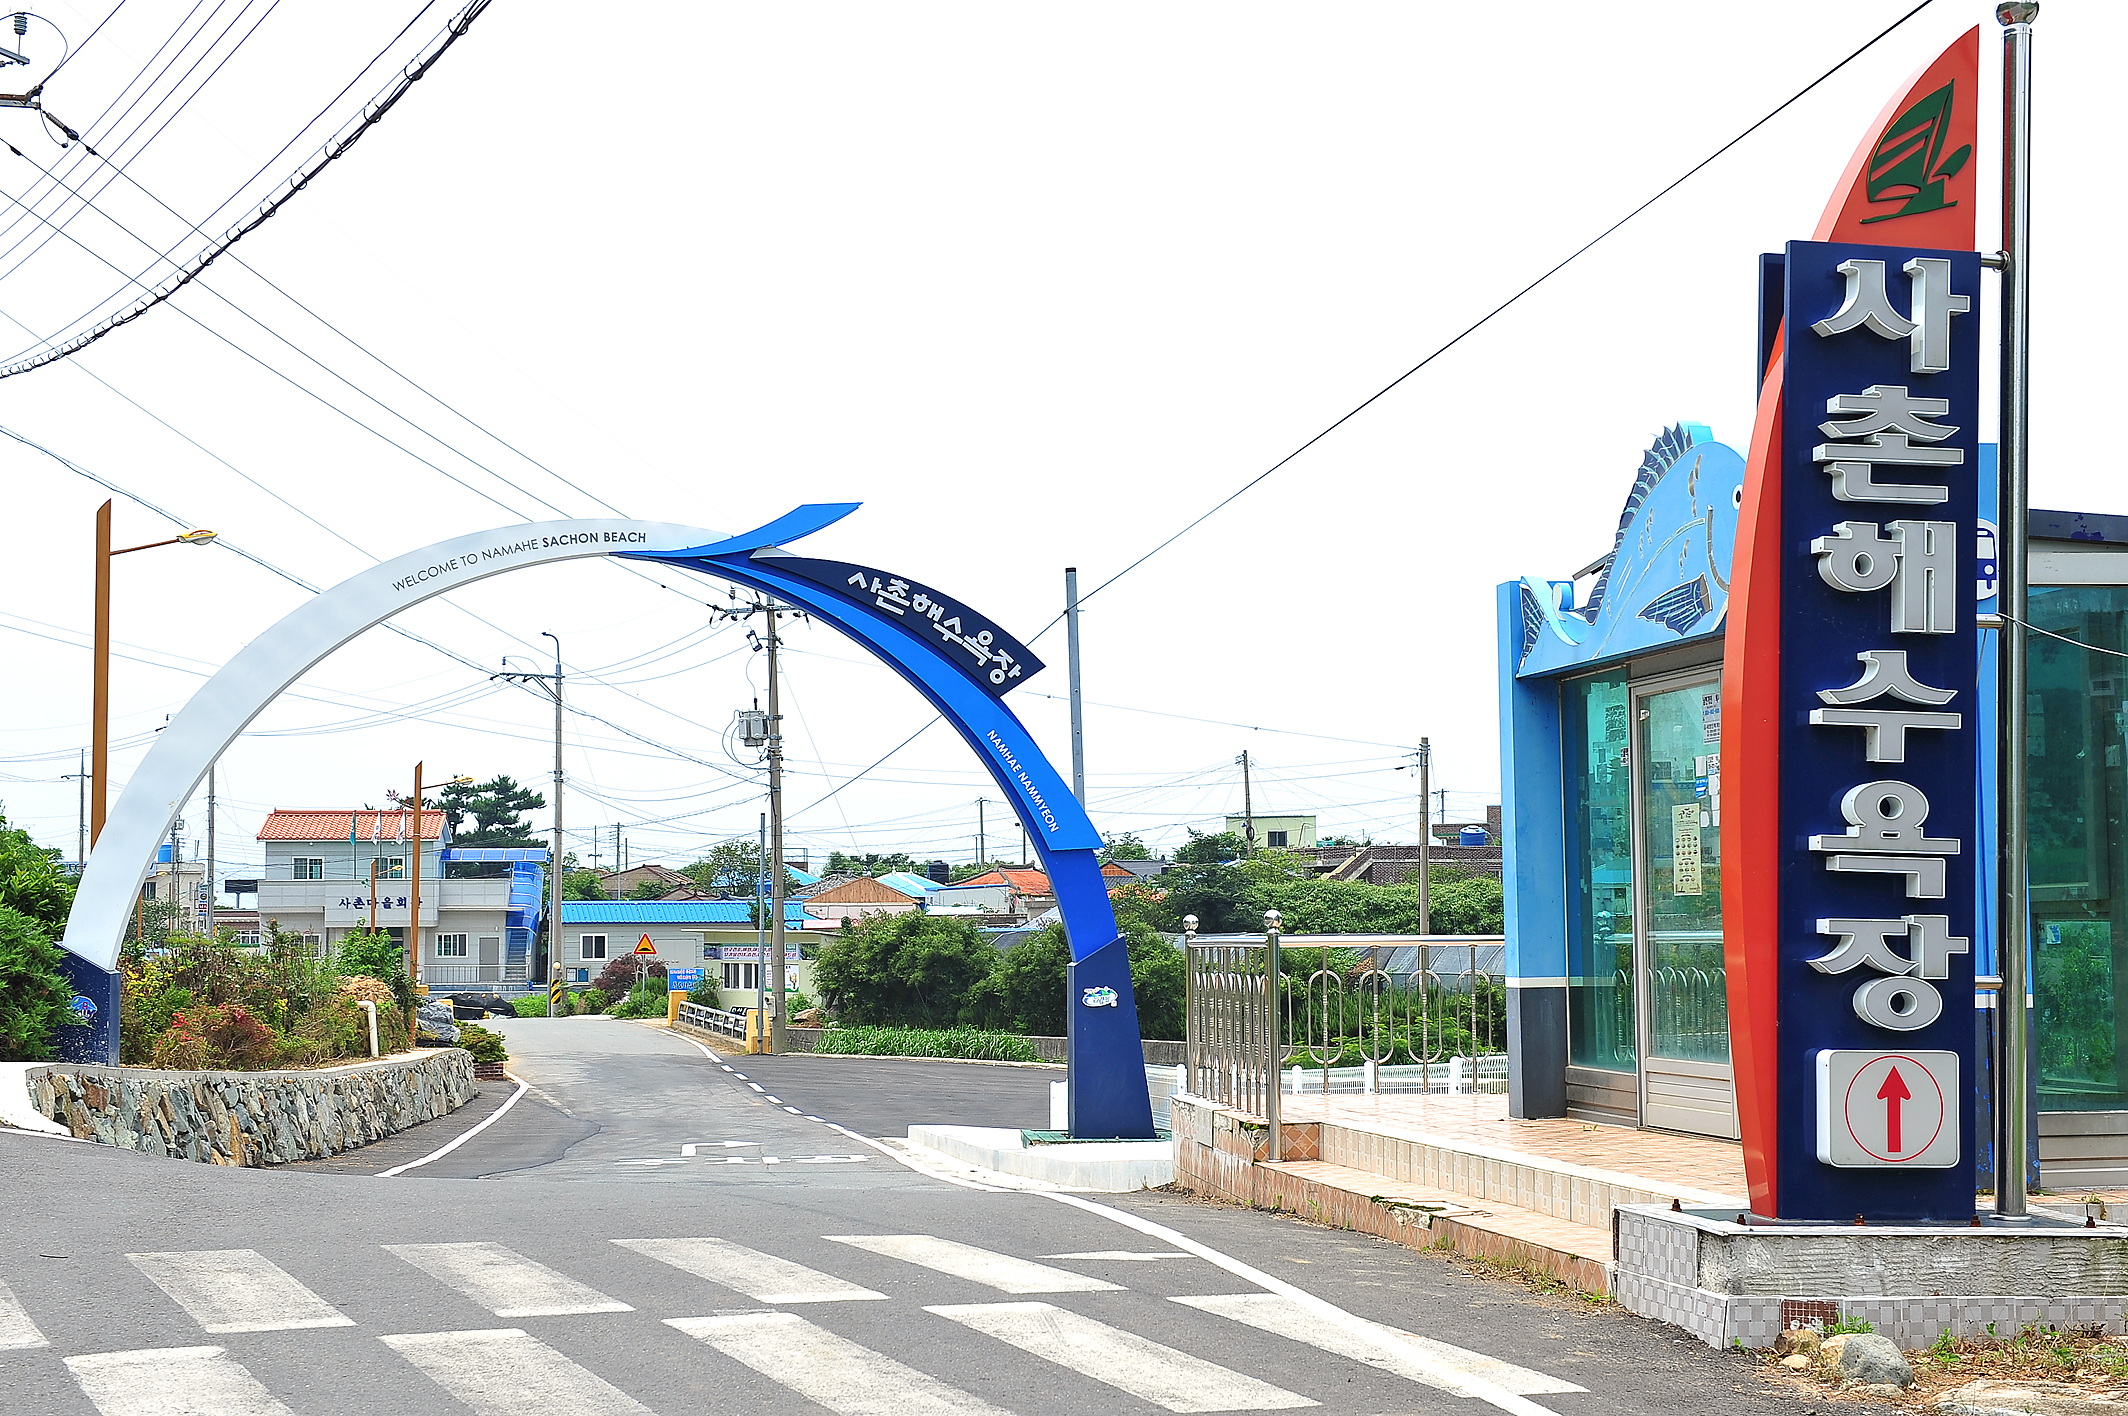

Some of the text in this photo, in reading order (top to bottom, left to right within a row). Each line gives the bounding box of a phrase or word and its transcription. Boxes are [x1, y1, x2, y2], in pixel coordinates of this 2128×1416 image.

[392, 531, 647, 592] WELCOME TO NAMAHE SACHON BEACH
[847, 571, 1023, 685] 사촌해수욕장
[1807, 257, 1970, 1031] 사촌해수욕장
[986, 729, 1059, 833] NAMHAE NAMMYEON
[338, 896, 423, 910] 사촌마을회
